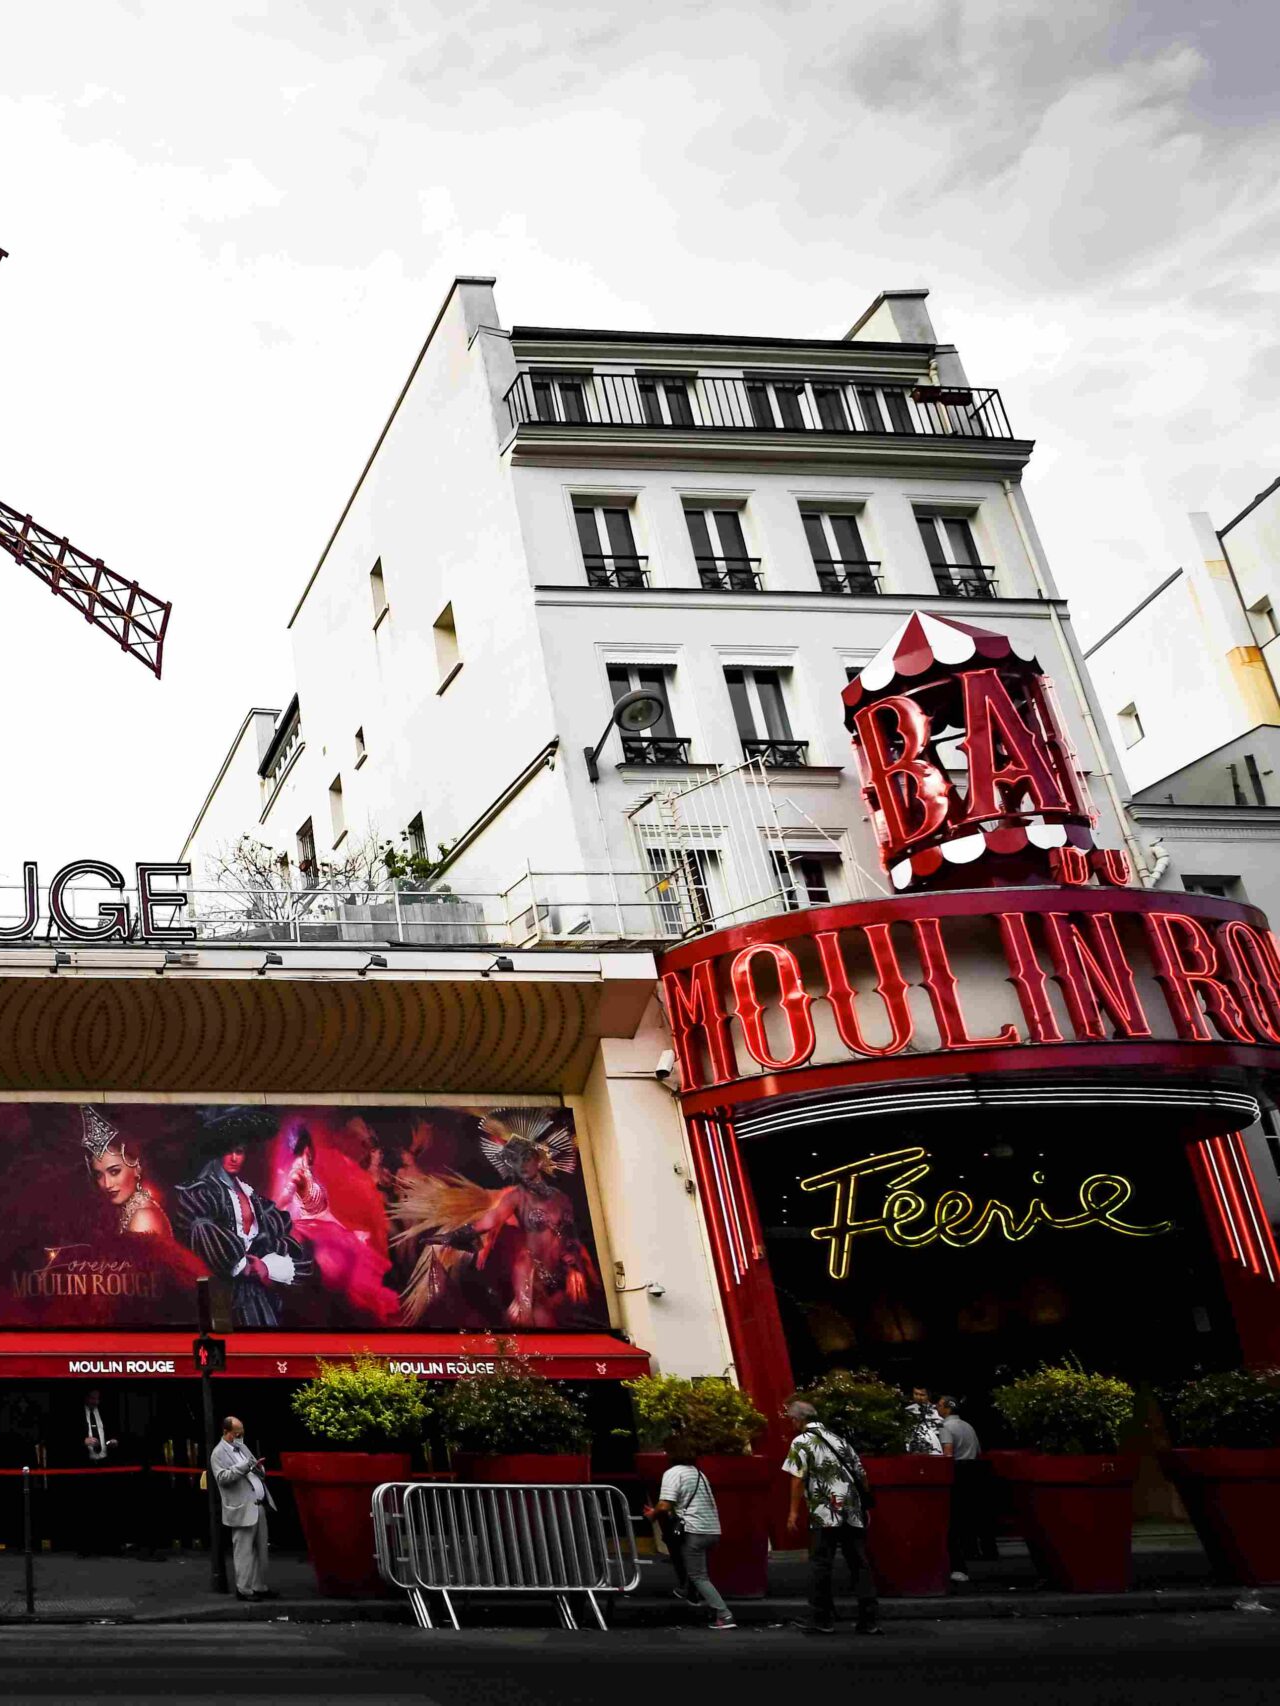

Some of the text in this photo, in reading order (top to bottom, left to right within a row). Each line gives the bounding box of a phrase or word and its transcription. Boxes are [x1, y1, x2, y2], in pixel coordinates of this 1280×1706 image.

[1056, 846, 1132, 886] DU
[661, 912, 1153, 1091] MOULIN
[800, 1146, 1176, 1280] Féerie
[33, 1244, 133, 1281] Forever
[12, 1271, 162, 1297] MOULIN ROUGE
[69, 1360, 175, 1373] MOULIN ROUGE
[389, 1362, 495, 1374] MOULIN ROUGE
